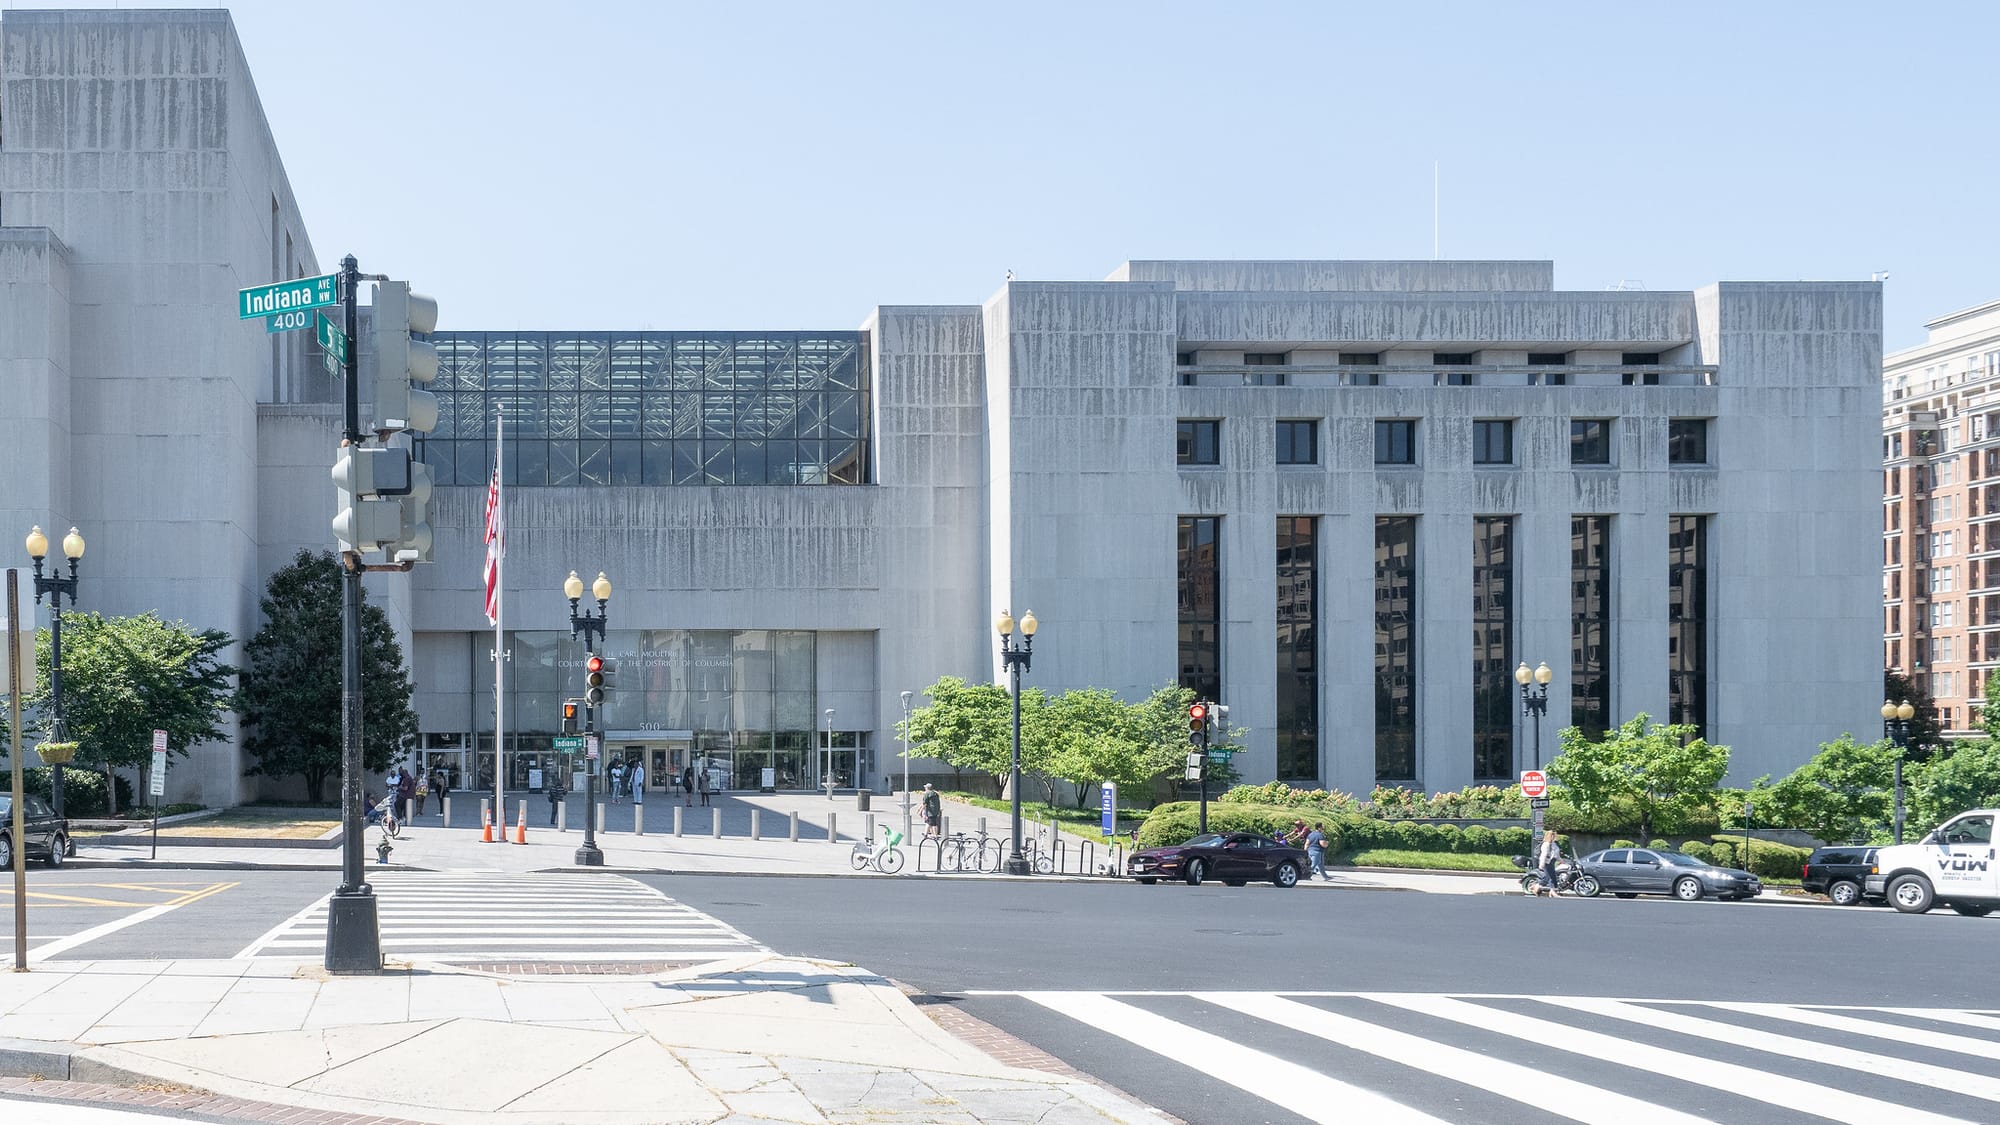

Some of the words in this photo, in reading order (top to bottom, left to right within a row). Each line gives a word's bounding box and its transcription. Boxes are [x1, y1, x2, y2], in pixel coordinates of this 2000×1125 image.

[318, 279, 331, 290] AVE
[246, 287, 312, 314] Indiana
[319, 292, 330, 302] NW
[274, 311, 306, 329] 400
[619, 650, 638, 658] CARL
[640, 650, 679, 658] MOULTRIE
[628, 660, 642, 668] THE
[645, 660, 677, 668] DISTRICT
[681, 660, 691, 668] OF
[694, 660, 733, 668] COLUMBIA
[639, 722, 660, 732] 500
[555, 739, 577, 747] Indiana
